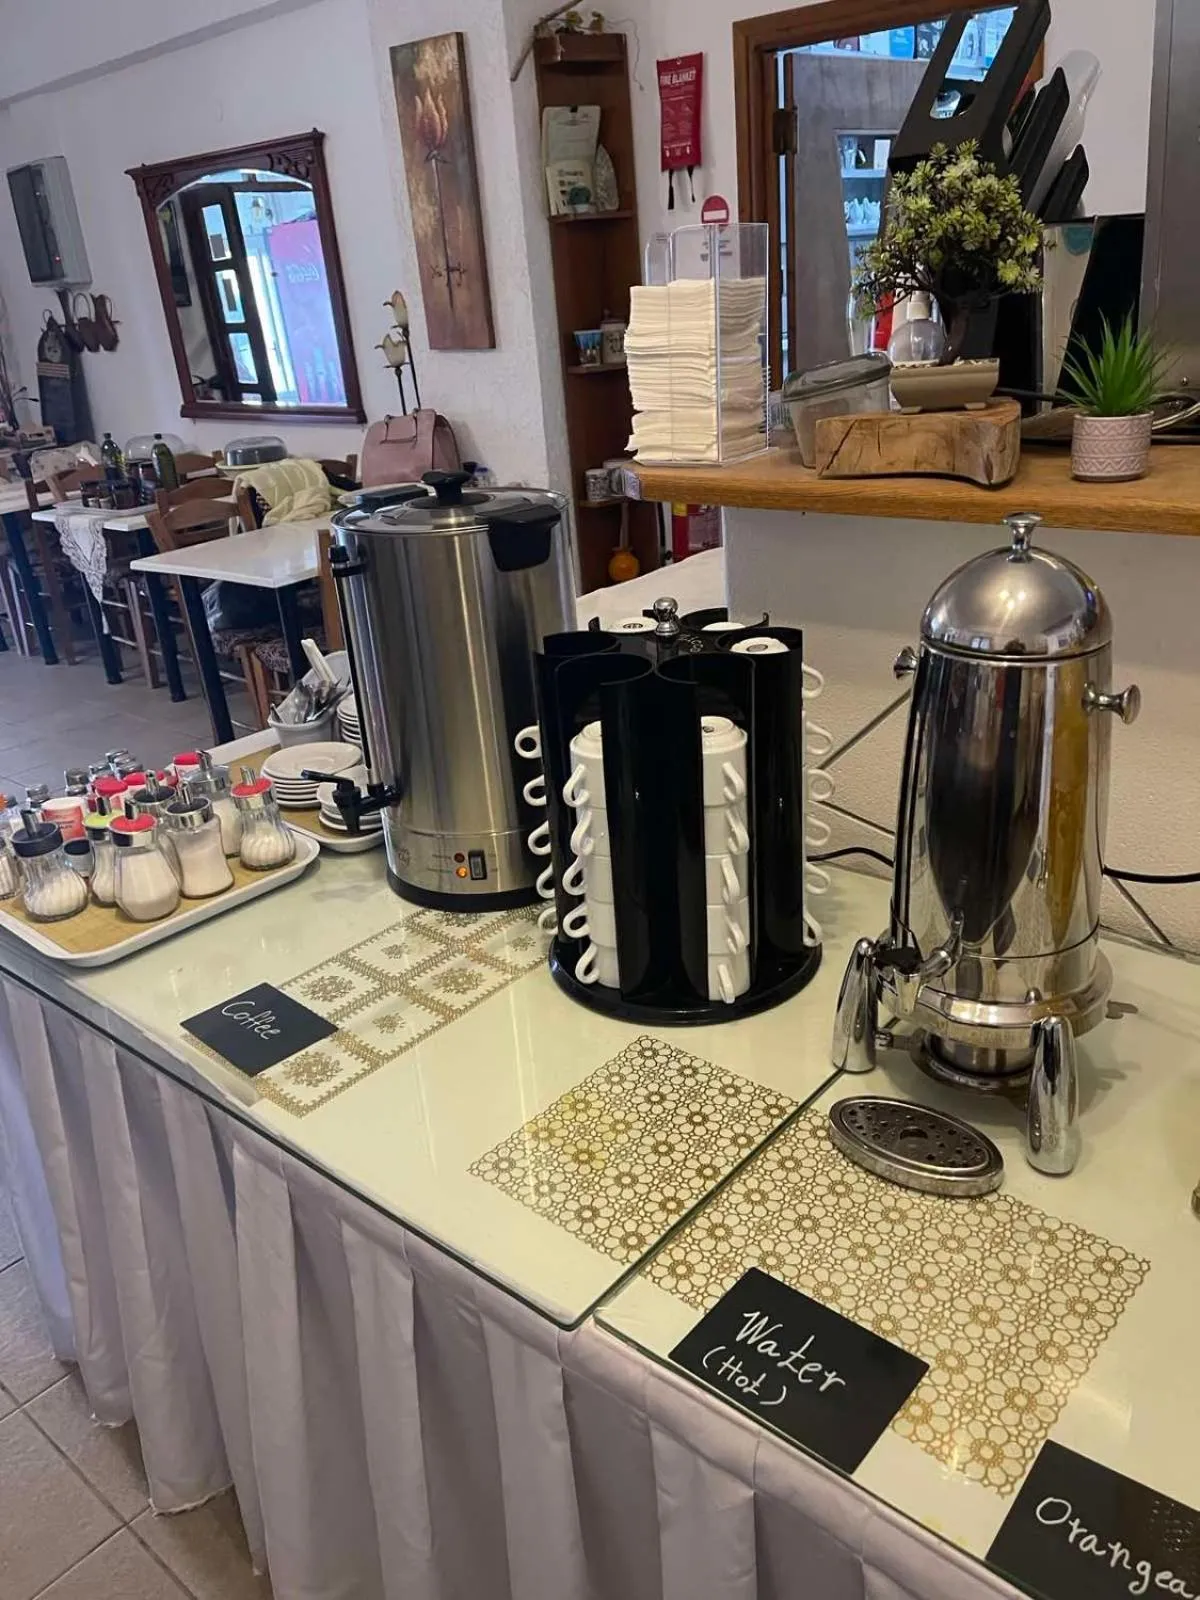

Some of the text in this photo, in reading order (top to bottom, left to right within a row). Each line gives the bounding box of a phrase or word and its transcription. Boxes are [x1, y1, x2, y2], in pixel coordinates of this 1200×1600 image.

[672, 70, 696, 84] BLANKET
[221, 1001, 280, 1040] Coffee
[702, 1345, 787, 1405] (Hot)
[735, 1311, 846, 1392] Water
[1036, 1497, 1200, 1600] Orangea
